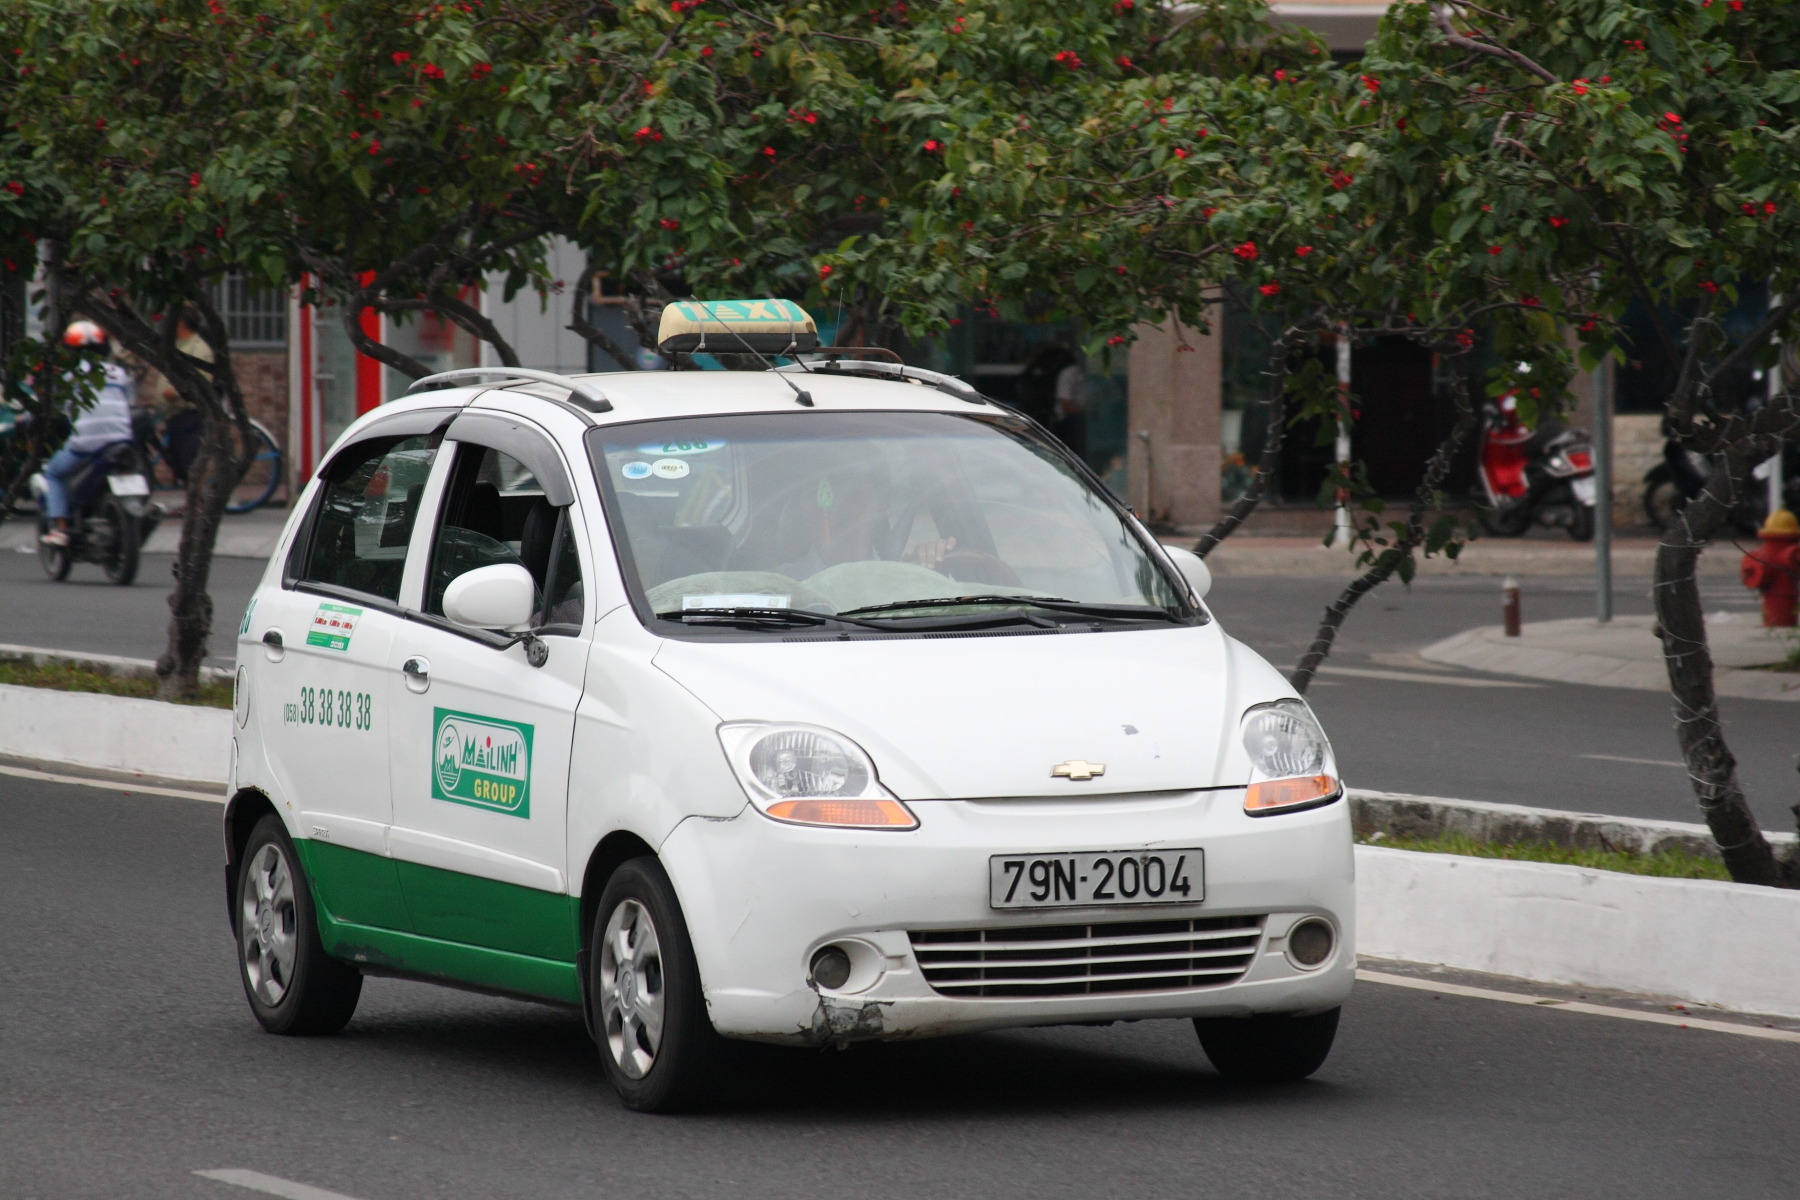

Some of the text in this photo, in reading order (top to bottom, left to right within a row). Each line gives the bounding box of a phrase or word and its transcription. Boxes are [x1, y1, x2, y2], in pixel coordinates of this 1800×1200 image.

[300, 686, 315, 724] 38
[319, 688, 333, 726] 38
[337, 690, 352, 729] 38
[356, 692, 371, 731] 38
[474, 778, 516, 804] GROUP
[1003, 855, 1191, 903] 79N-2004
